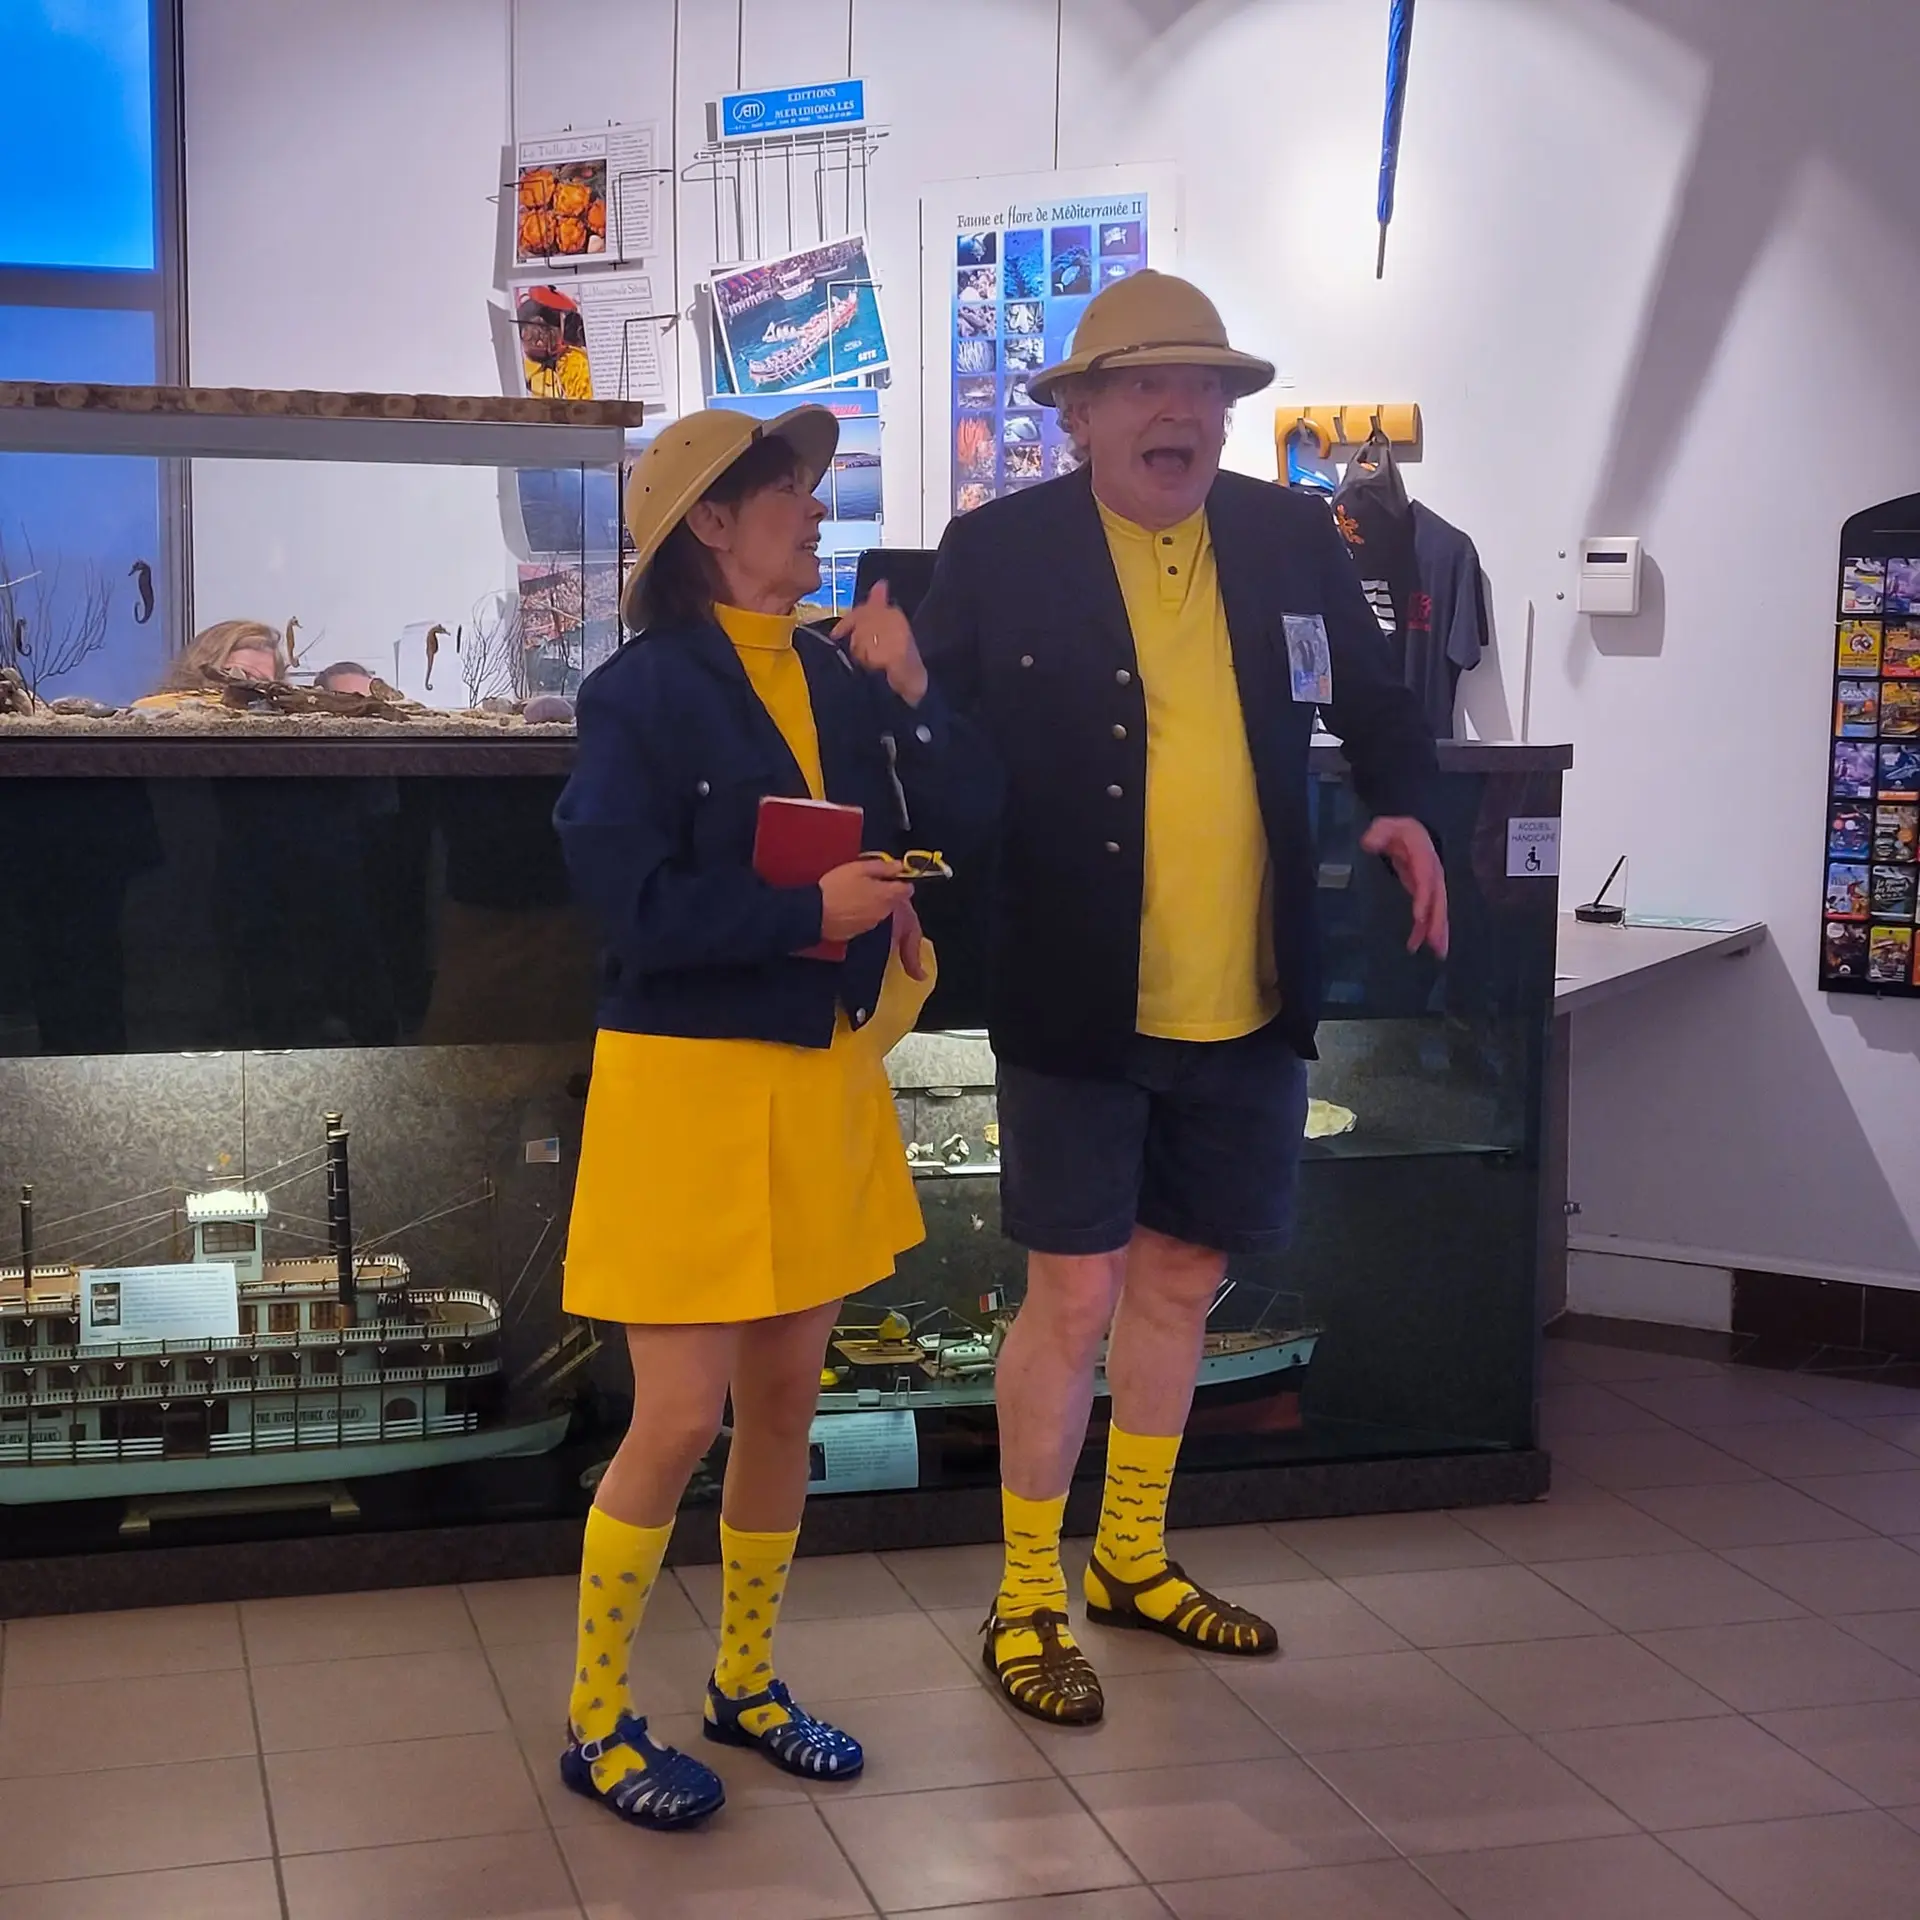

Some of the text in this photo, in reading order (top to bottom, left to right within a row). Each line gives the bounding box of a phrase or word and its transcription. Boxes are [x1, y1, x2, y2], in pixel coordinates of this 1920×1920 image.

[787, 87, 836, 102] EDITIONS
[774, 100, 855, 119] MERIDIONALES
[957, 201, 1142, 229] Faune et flore de Méditerranée II
